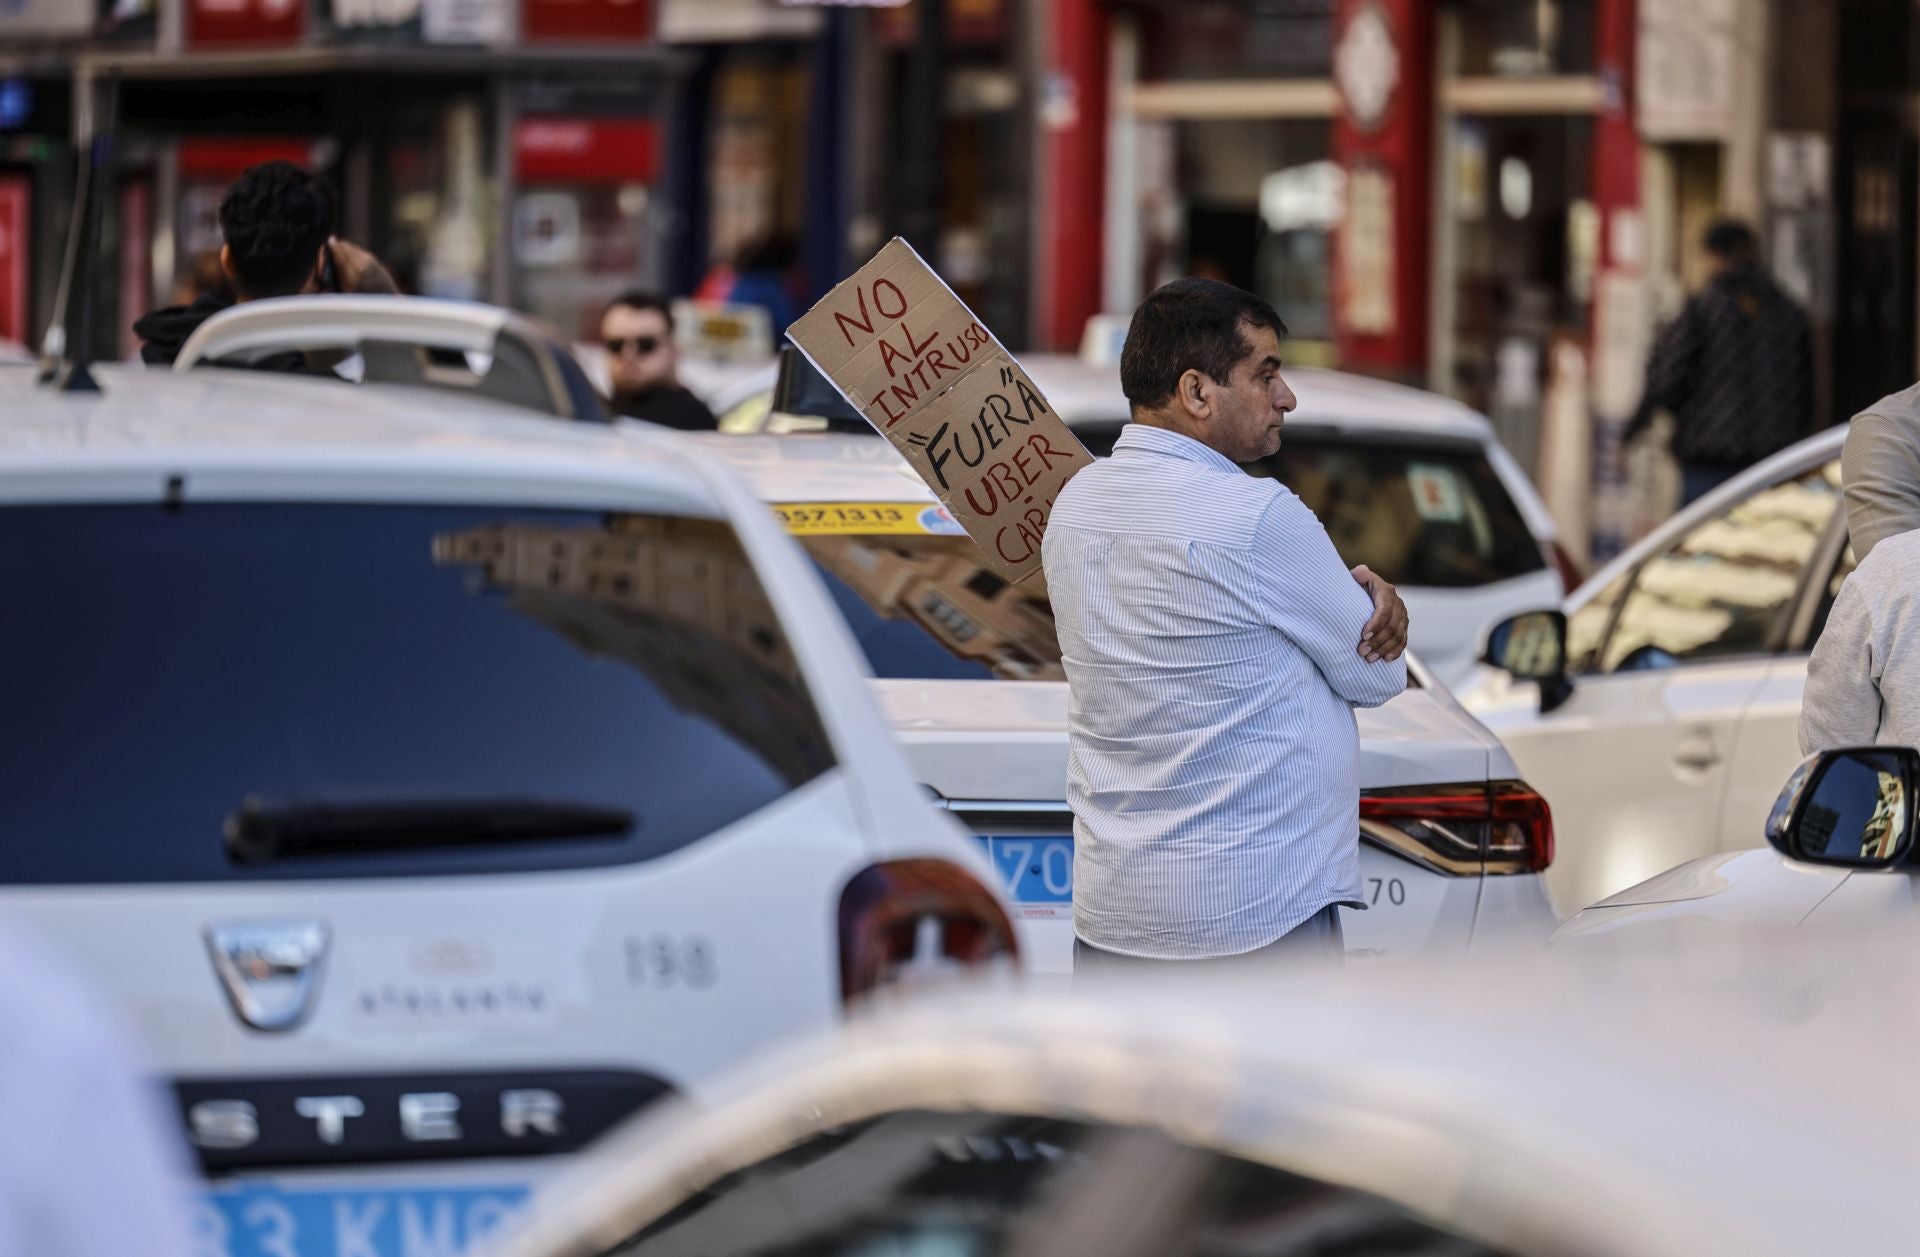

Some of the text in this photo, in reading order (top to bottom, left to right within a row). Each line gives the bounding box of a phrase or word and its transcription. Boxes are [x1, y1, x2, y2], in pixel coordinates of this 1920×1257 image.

[834, 278, 907, 347] NO
[870, 322, 990, 428] INTRUSO
[878, 322, 939, 377] AL
[964, 434, 1074, 517] UBER
[1368, 878, 1405, 906] 70
